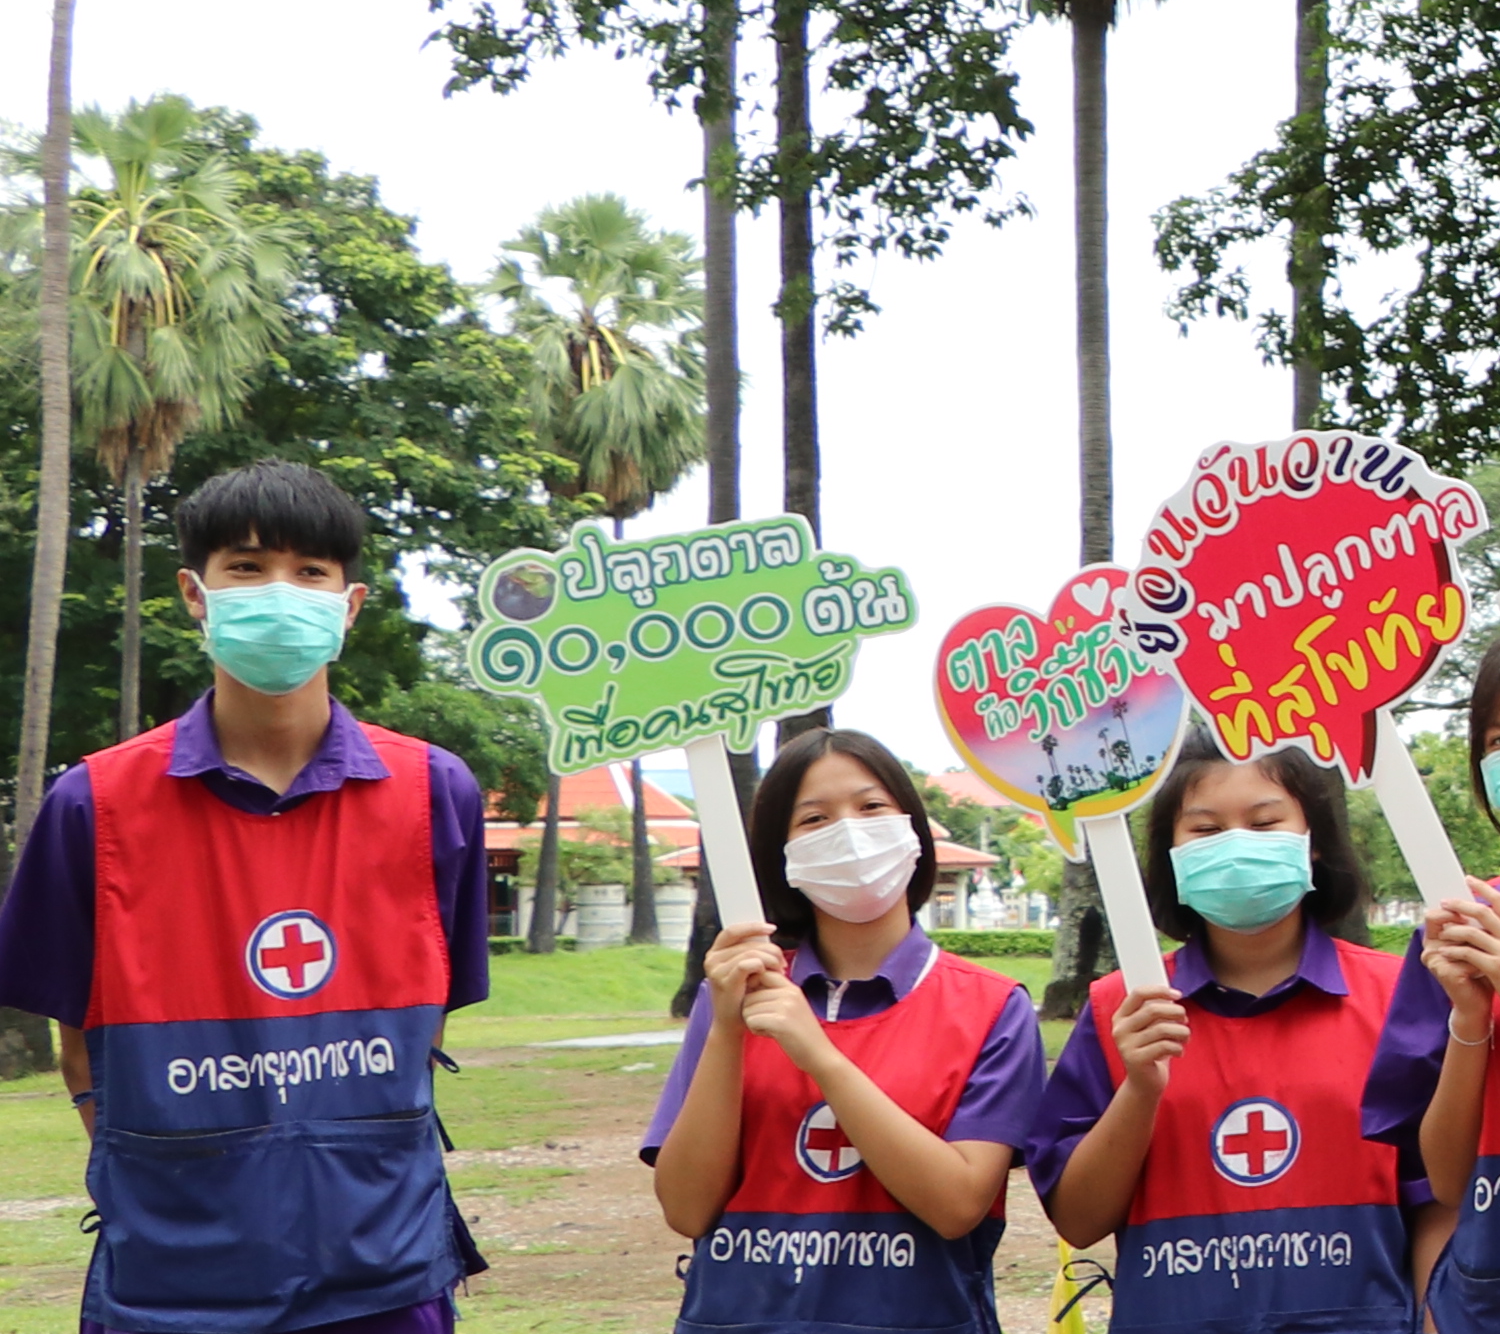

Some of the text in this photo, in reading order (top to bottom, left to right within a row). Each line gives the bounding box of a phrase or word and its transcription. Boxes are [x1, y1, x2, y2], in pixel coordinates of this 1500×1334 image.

[562, 524, 801, 607] ปลูกตาล
[1118, 436, 1412, 655] ย้อนวันวาน
[1197, 488, 1477, 640] มาปลูกตาล
[481, 560, 909, 685] ๑๐,๐๐๐ ต้น
[949, 616, 1035, 690] ตาล
[1210, 586, 1463, 760] ที่สุโขทัย
[563, 641, 850, 764] เพื่อคนสุโขทัย
[168, 1036, 395, 1104] อาสายุวกาชาด
[710, 1226, 915, 1284] อาสายุวกาชาด
